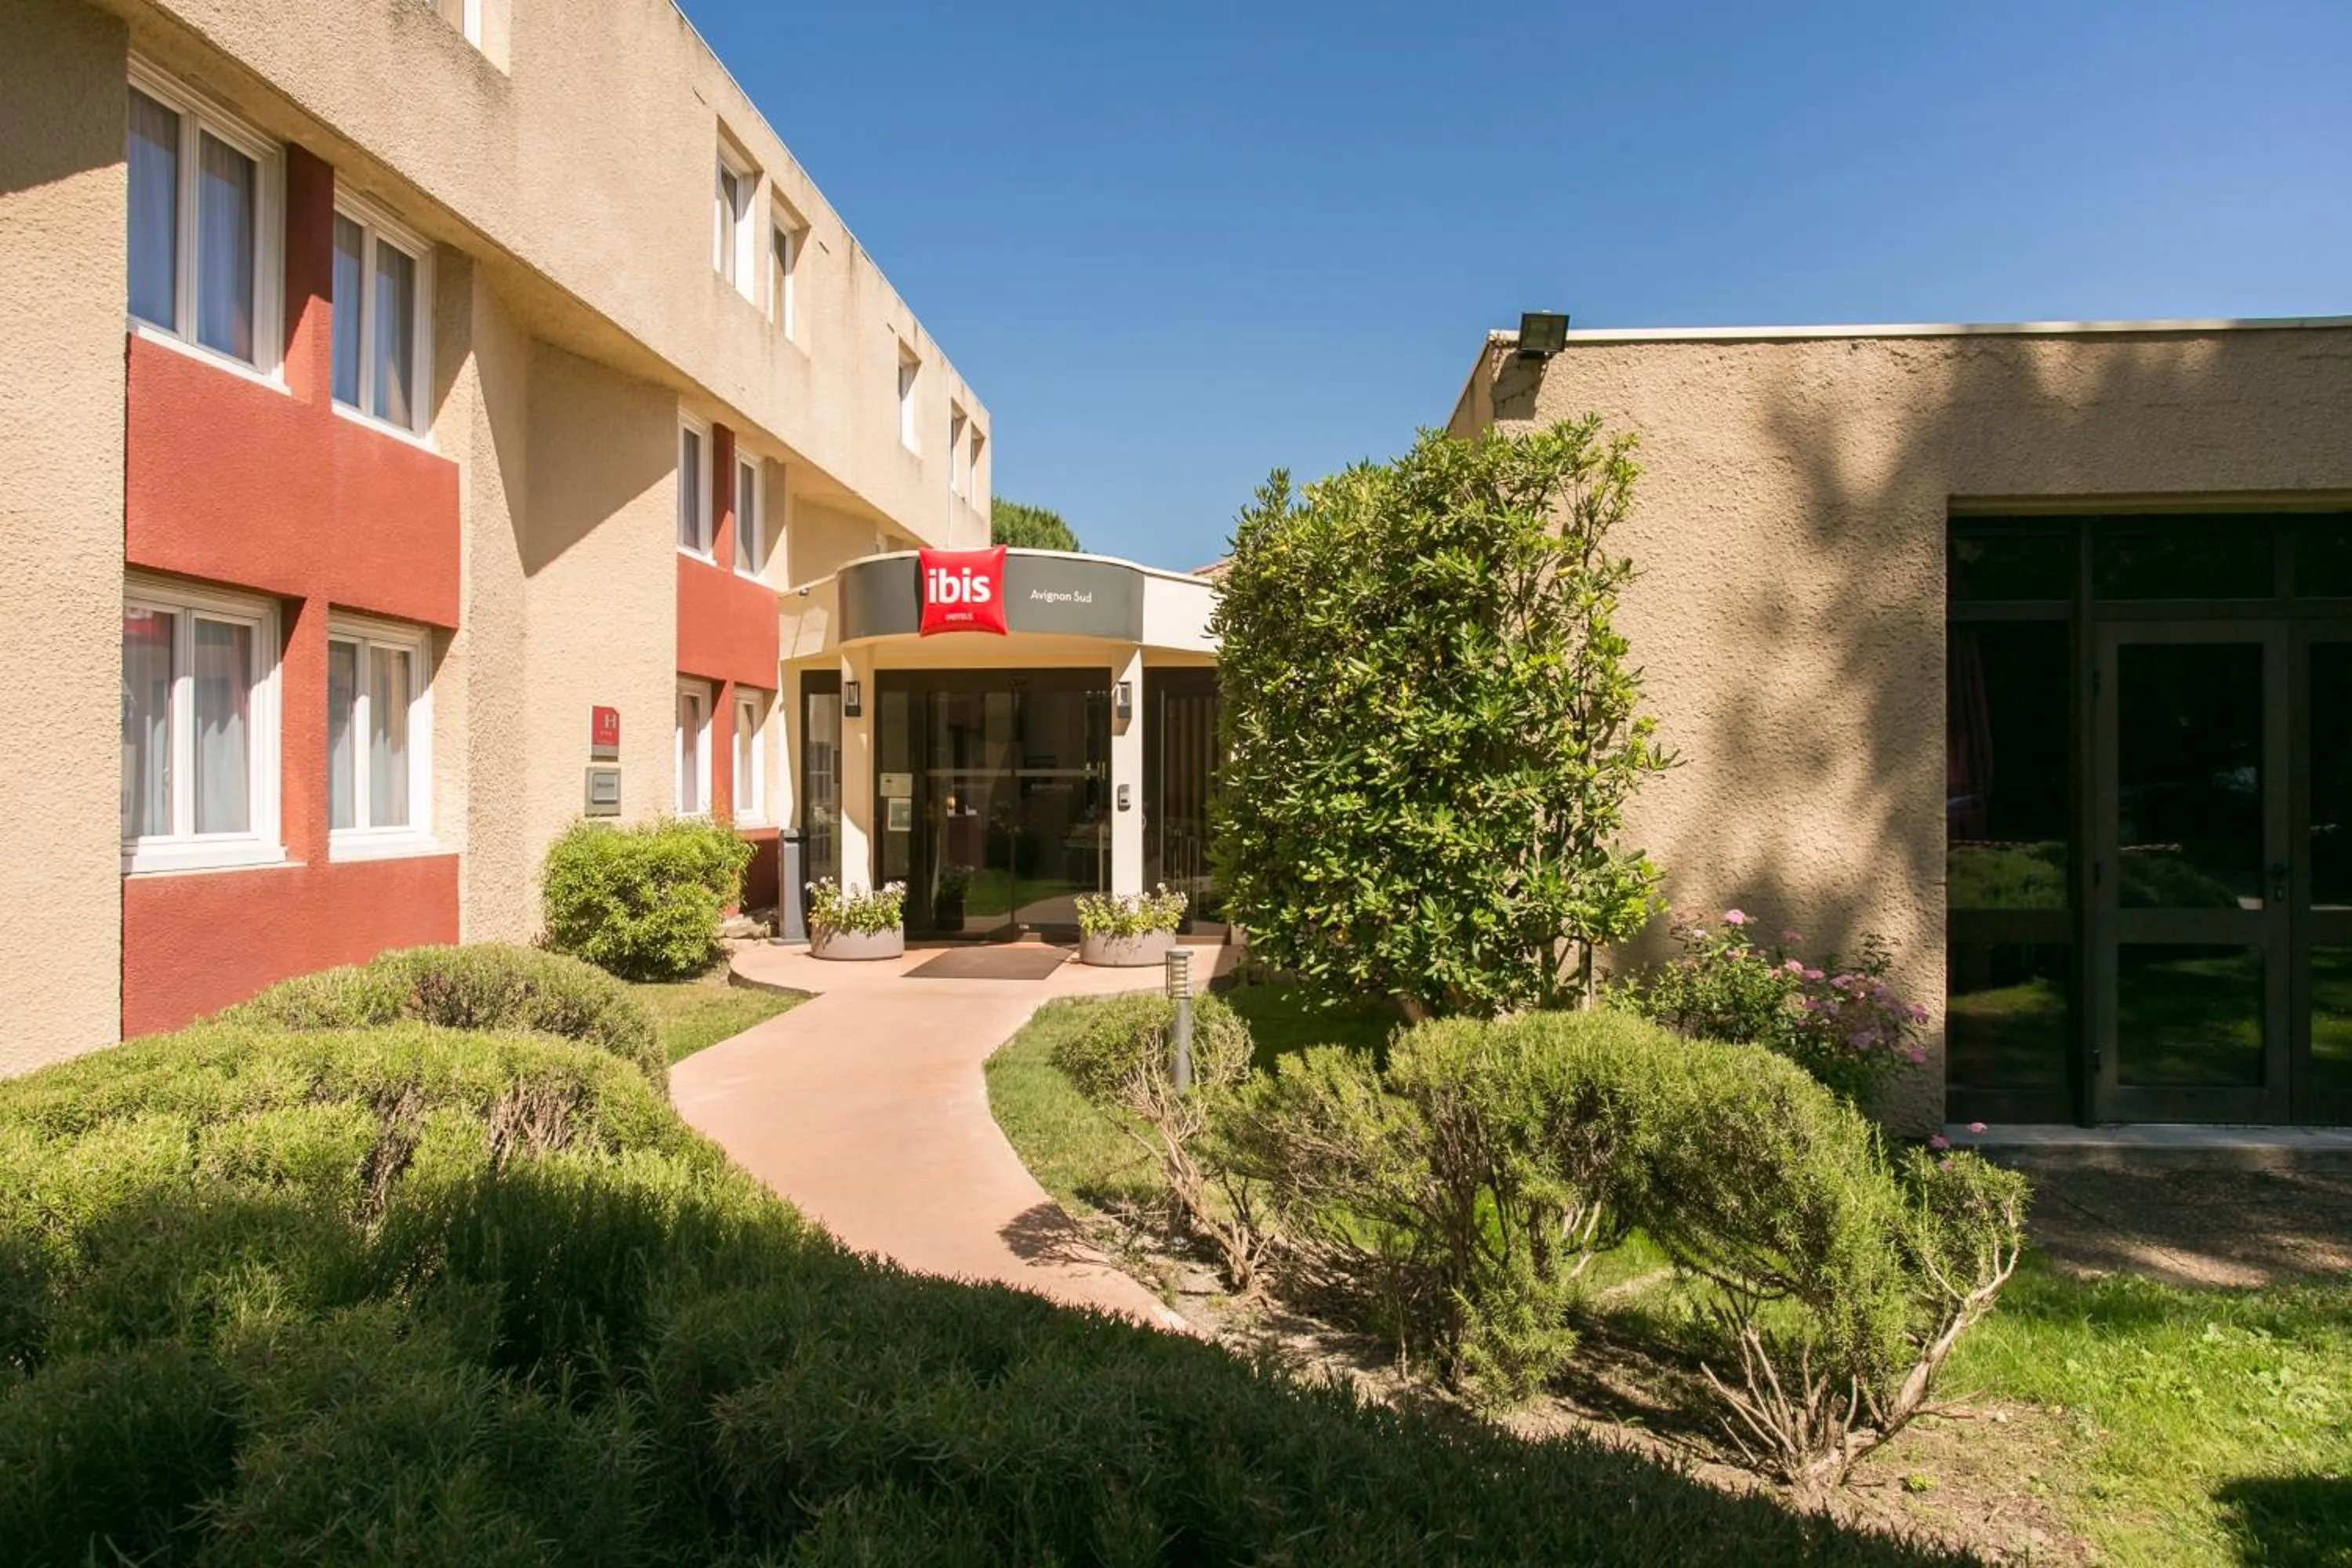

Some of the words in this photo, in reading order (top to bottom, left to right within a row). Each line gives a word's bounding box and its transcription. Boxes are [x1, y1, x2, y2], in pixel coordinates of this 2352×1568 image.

[928, 568, 991, 604] ibis
[1029, 590, 1072, 602] Avignon
[1073, 590, 1092, 602] Sud
[604, 714, 616, 728] H
